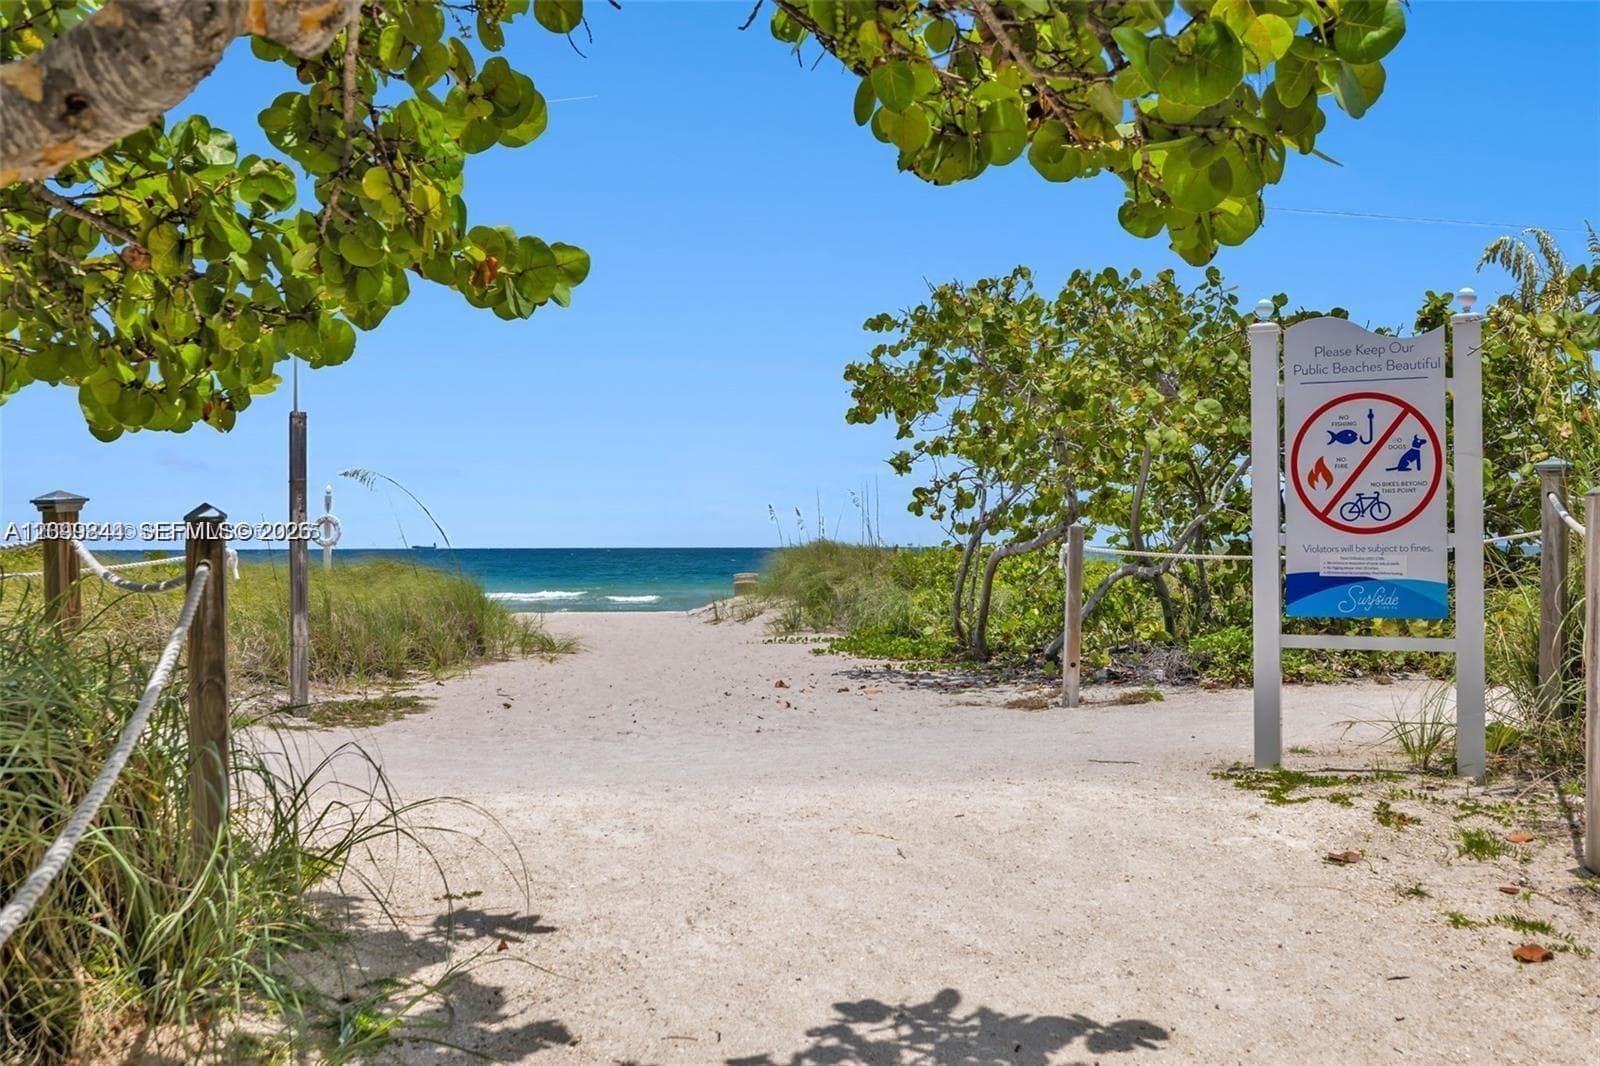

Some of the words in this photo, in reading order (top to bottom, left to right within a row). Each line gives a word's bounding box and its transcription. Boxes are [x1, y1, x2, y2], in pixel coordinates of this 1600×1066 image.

[1314, 345, 1351, 358] Please
[1355, 343, 1386, 359] Keep
[1389, 341, 1415, 354] Our
[1293, 363, 1329, 376] Public
[1332, 361, 1382, 374] Beaches
[1386, 357, 1441, 372] Beautiful
[1302, 544, 1340, 554] Violators
[1340, 543, 1354, 554] will
[1355, 543, 1366, 553] be
[1367, 544, 1398, 556] subject
[1399, 544, 1409, 553] to
[1410, 543, 1434, 553] fines.
[1337, 584, 1400, 614] Surfside
